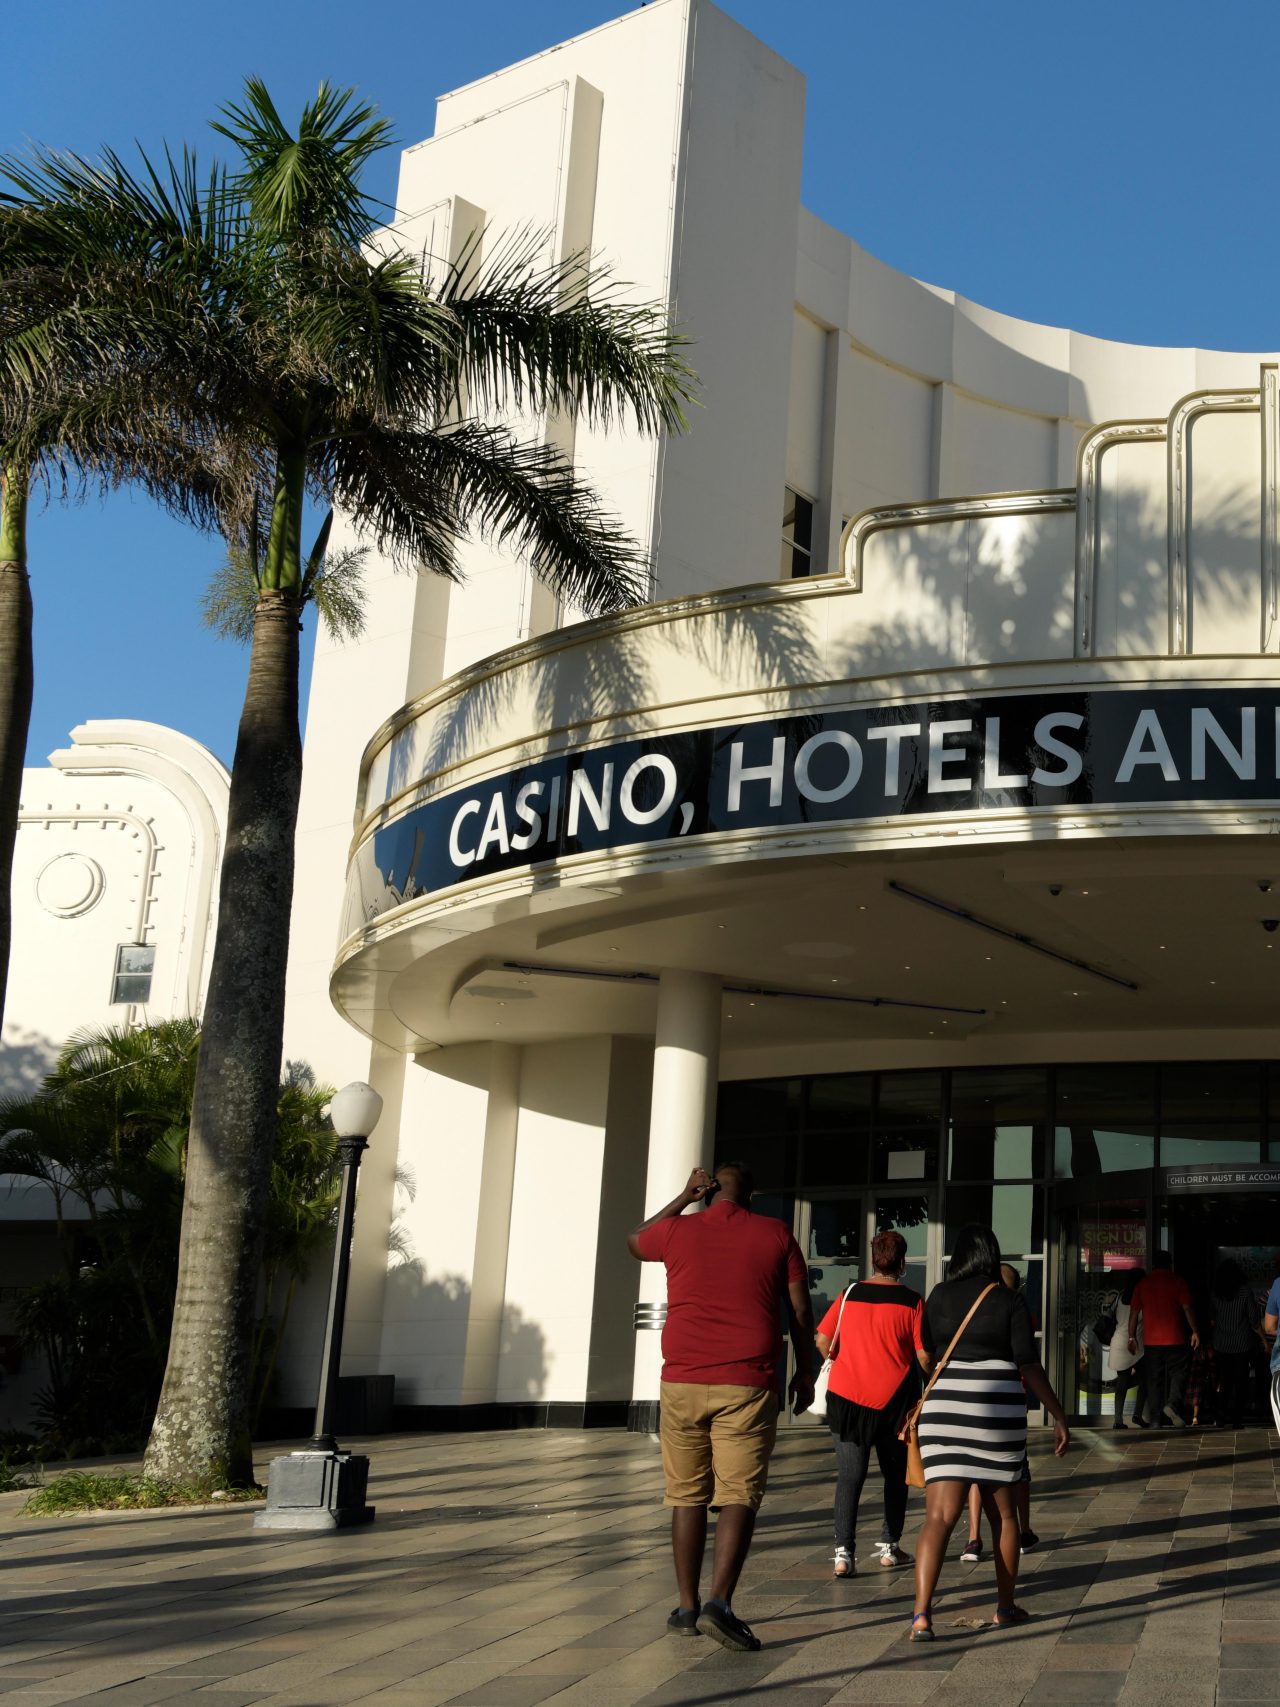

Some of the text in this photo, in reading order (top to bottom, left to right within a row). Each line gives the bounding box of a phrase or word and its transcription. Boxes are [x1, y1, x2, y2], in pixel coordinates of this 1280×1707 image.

[447, 752, 695, 868] CASINO,
[727, 711, 1085, 812] HOTELS
[1170, 1175, 1209, 1185] CHILDREN
[1211, 1174, 1232, 1183] MUST
[1235, 1174, 1246, 1182] BE
[1084, 1231, 1143, 1244] SIGN UP
